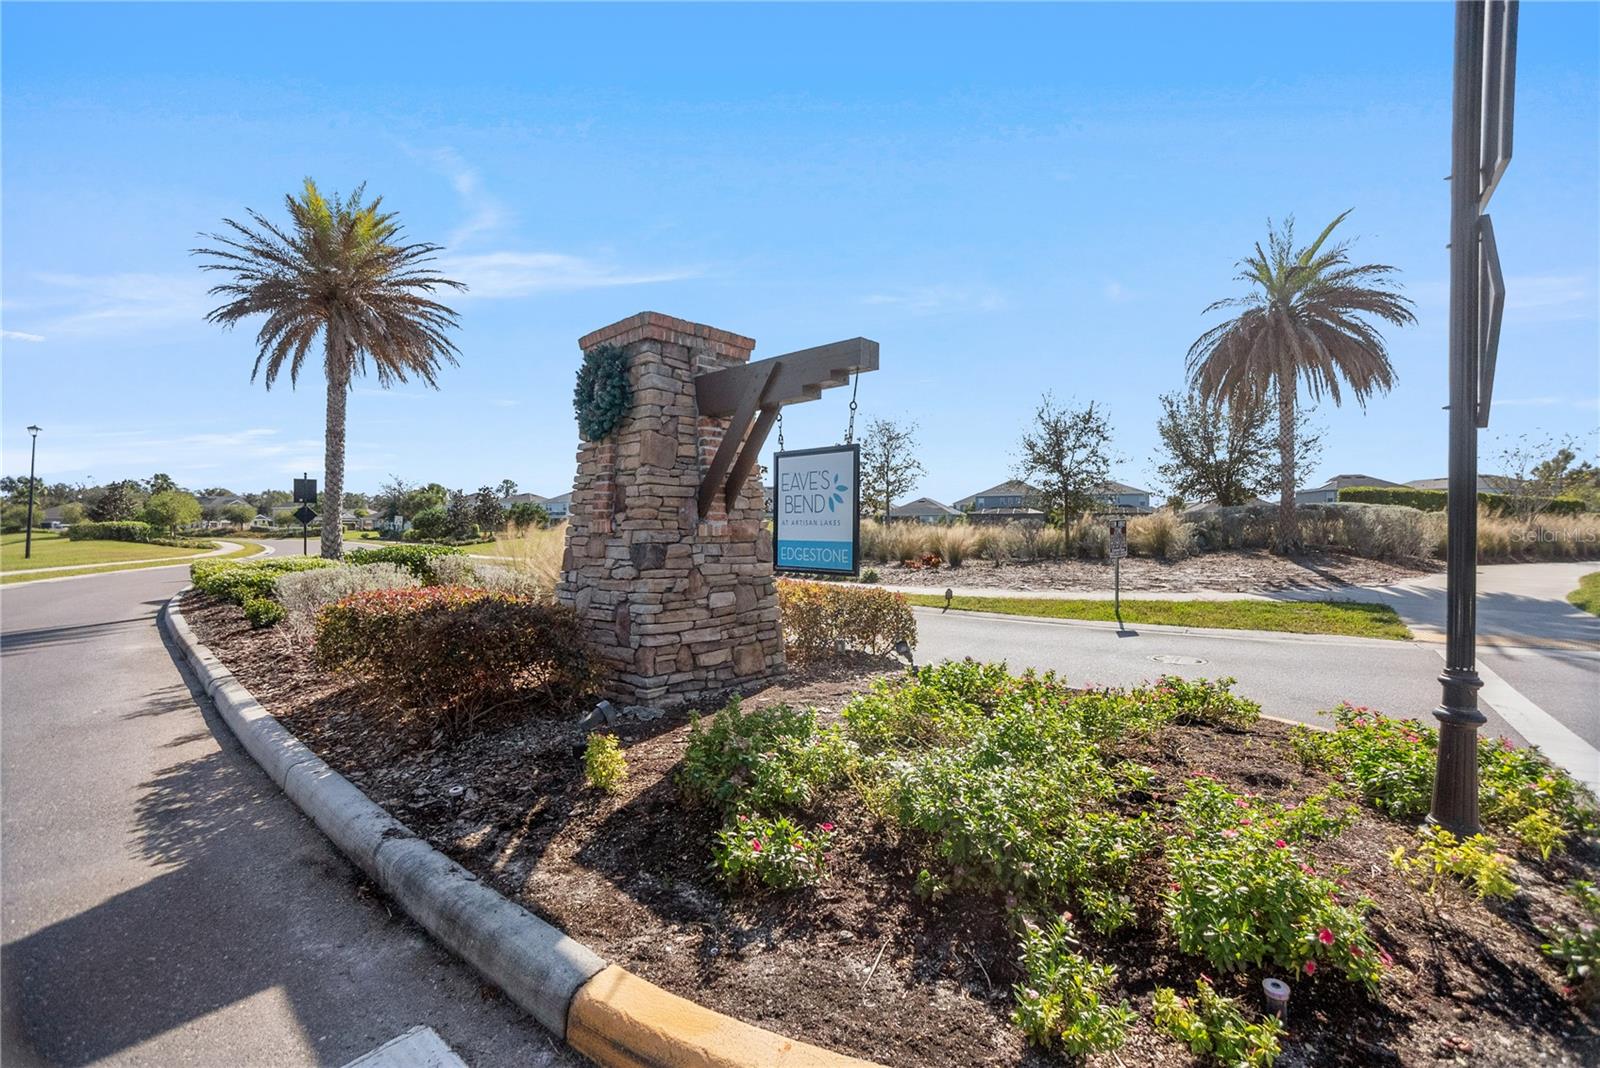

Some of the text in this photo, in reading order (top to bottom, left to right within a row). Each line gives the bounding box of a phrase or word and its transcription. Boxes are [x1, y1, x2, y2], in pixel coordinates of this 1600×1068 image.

[781, 470, 831, 492] EAVE'S
[784, 494, 826, 514] BEND
[791, 519, 818, 527] ARTISAN
[820, 519, 841, 527] LAKES
[780, 546, 849, 564] EDGESTONE
